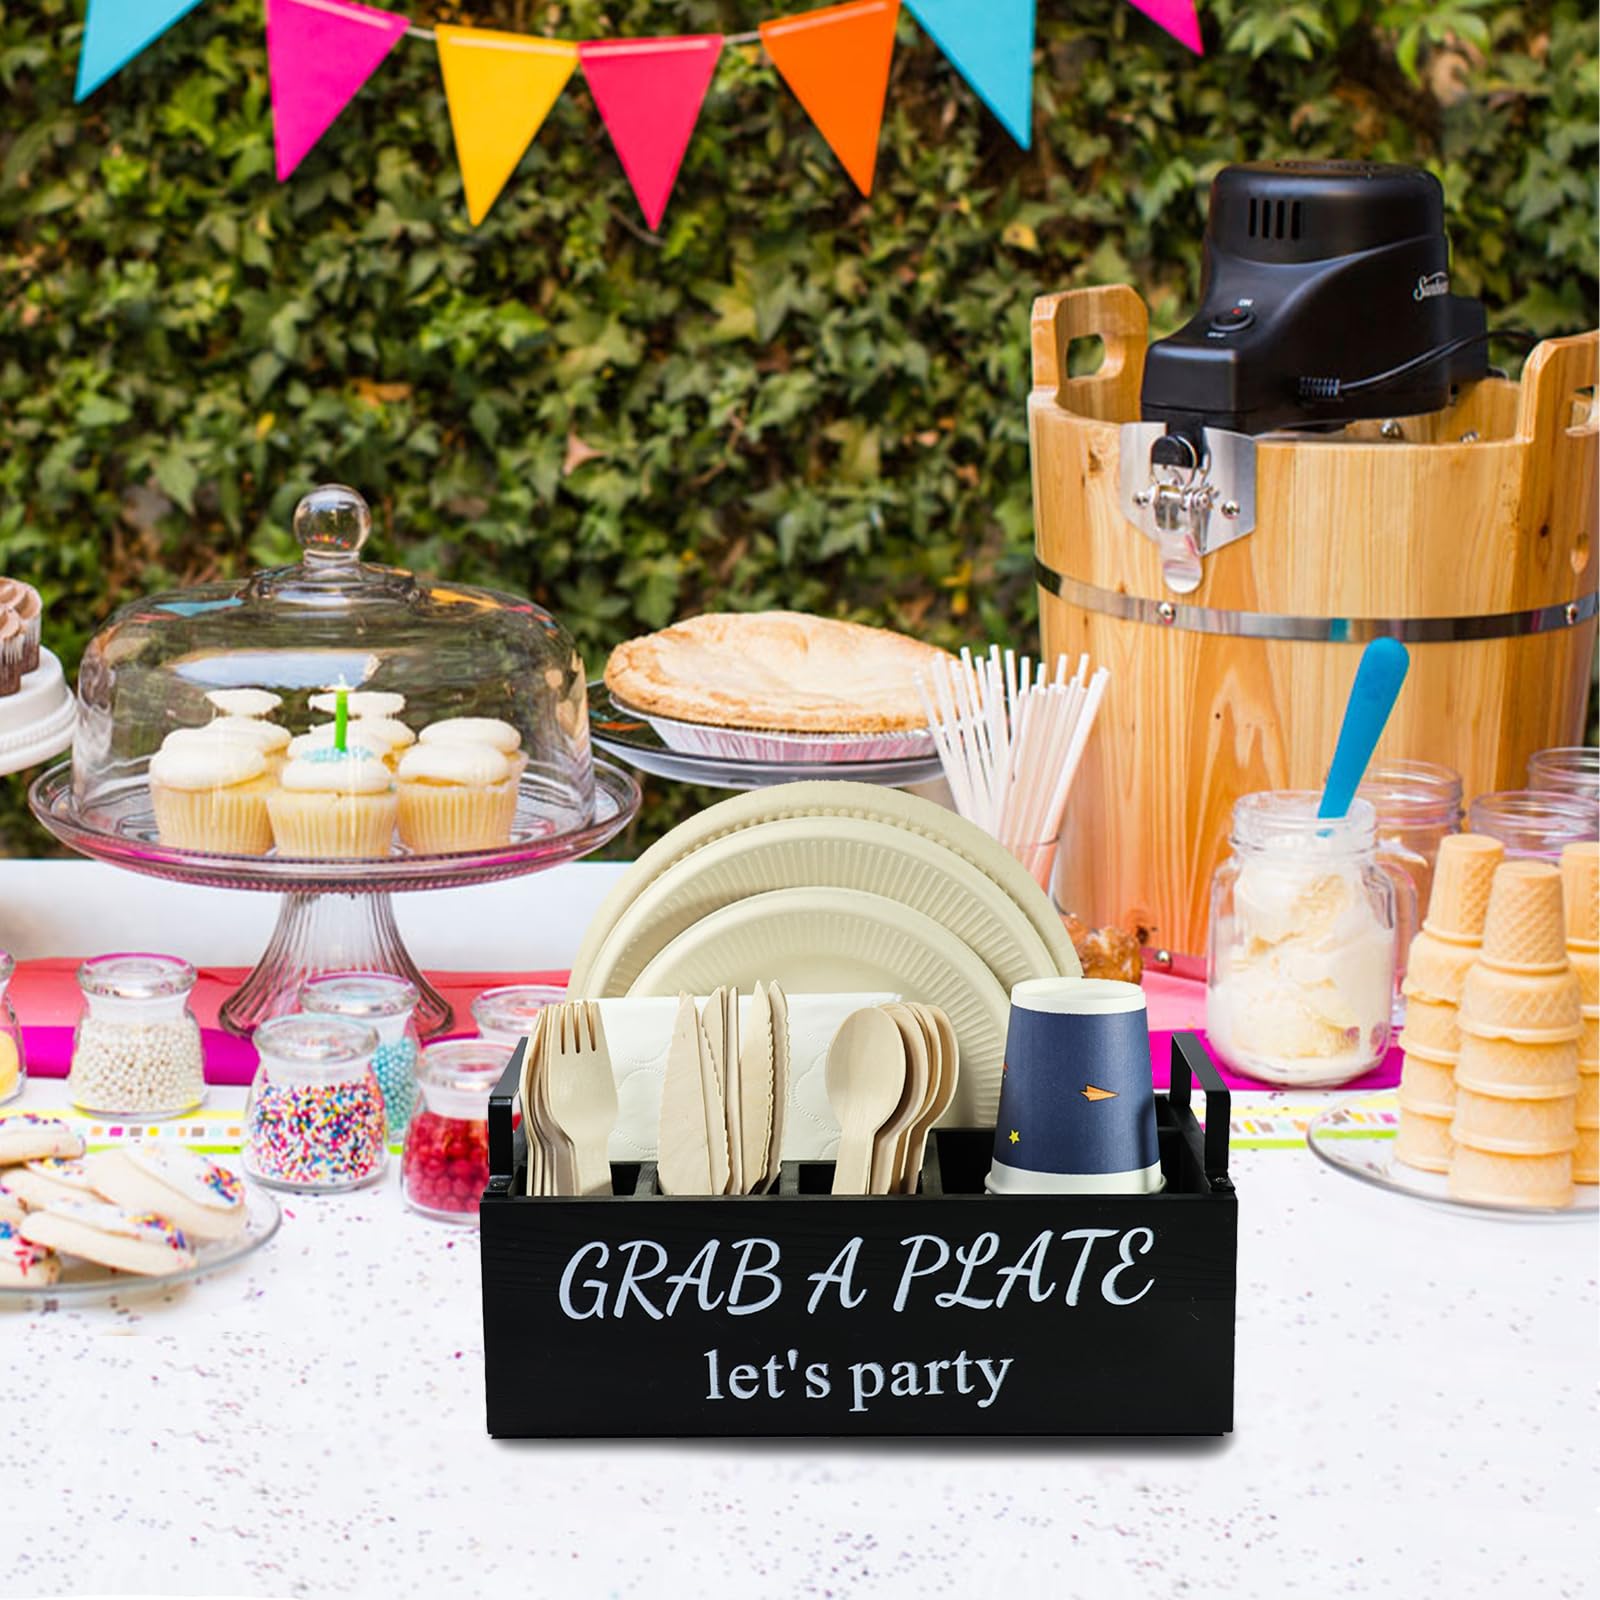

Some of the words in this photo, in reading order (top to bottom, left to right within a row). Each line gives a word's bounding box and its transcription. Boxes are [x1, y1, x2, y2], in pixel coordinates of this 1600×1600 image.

[558, 1238, 783, 1320] GRAB
[807, 1236, 867, 1315] A
[892, 1227, 1156, 1313] PLATE
[703, 1348, 831, 1401] let's
[847, 1350, 1014, 1412] party
